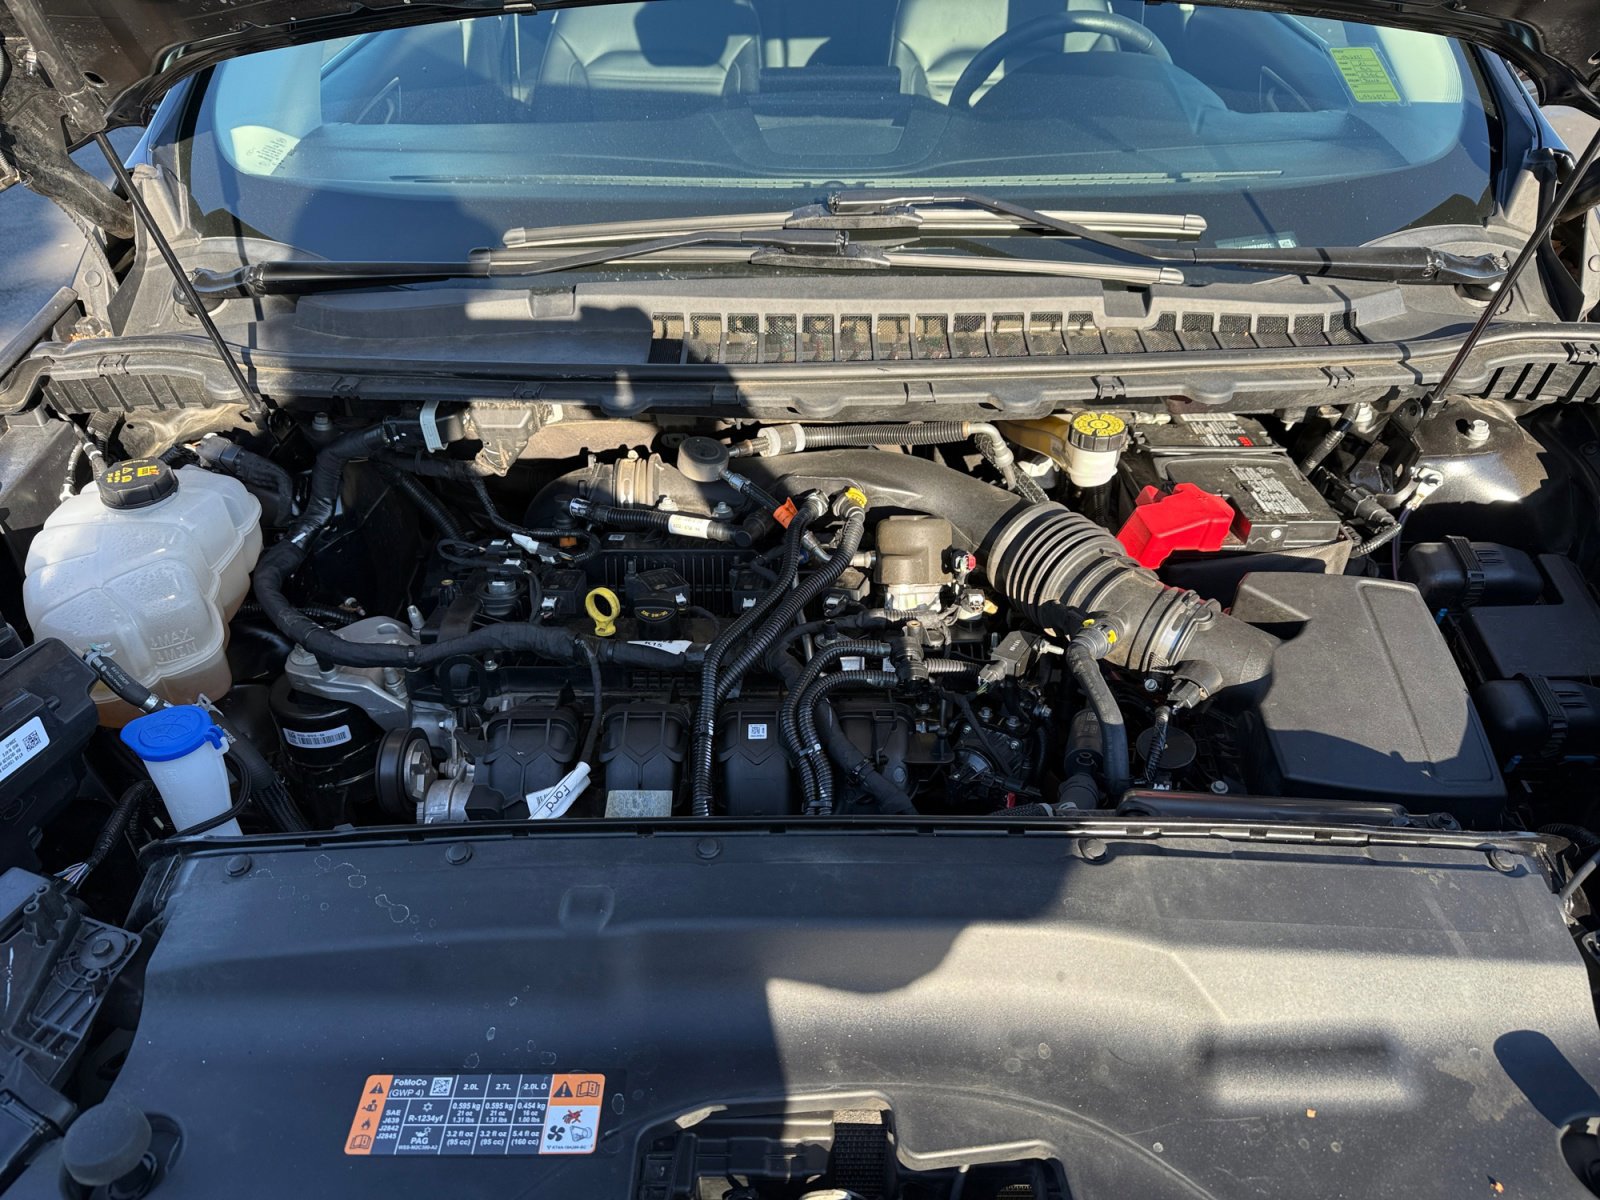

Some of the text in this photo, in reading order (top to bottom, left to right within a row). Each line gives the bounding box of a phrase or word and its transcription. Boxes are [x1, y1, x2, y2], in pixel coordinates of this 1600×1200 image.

[158, 628, 192, 646] MAX
[164, 641, 198, 660] MIN
[545, 784, 571, 812] Ford
[389, 1089, 424, 1097] (GWP 4)
[472, 1102, 481, 1111] kg
[505, 1102, 513, 1111] kg
[537, 1102, 546, 1111] kg
[408, 1115, 444, 1123] R-1234yf
